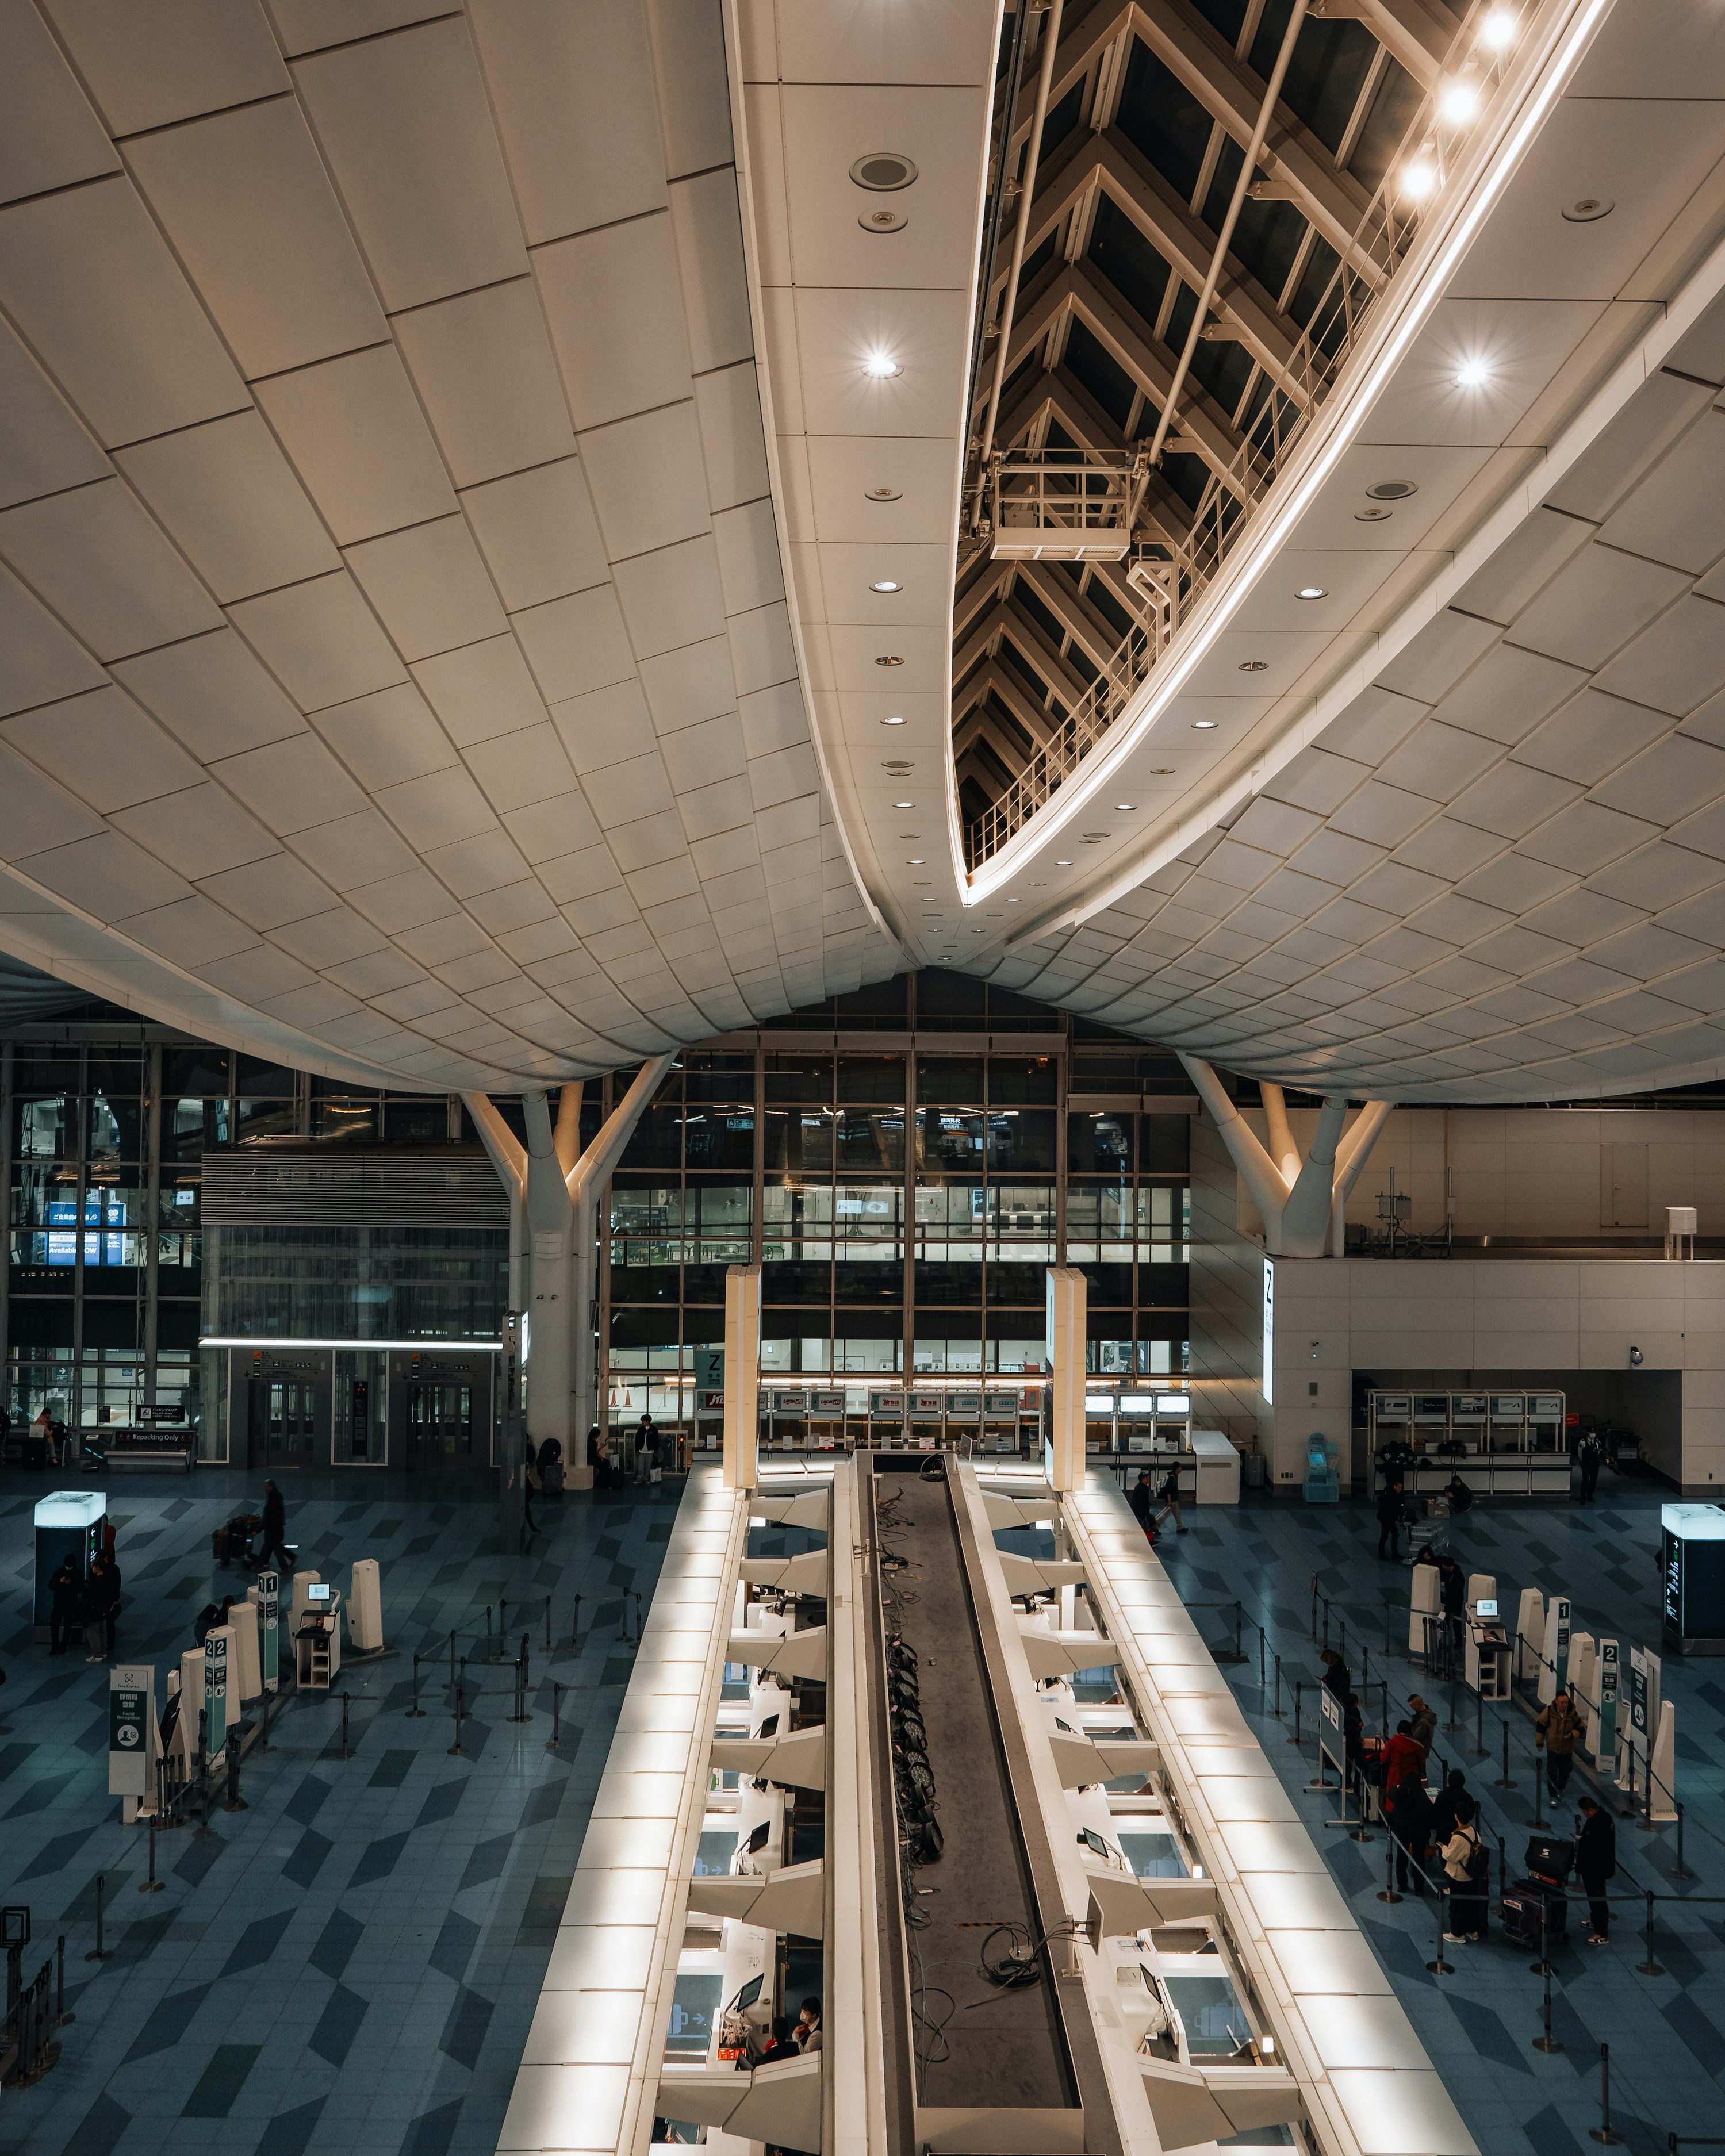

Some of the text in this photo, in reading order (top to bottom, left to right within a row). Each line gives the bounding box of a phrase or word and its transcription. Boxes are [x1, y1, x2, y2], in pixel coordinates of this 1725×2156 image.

[709, 1354, 720, 1371] Z
[260, 1578, 263, 1590] 1
[269, 1578, 274, 1590] 1
[1561, 1605, 1566, 1616] 1
[207, 1641, 212, 1655] 2
[217, 1641, 224, 1655] 2
[1606, 1647, 1615, 1660] 2
